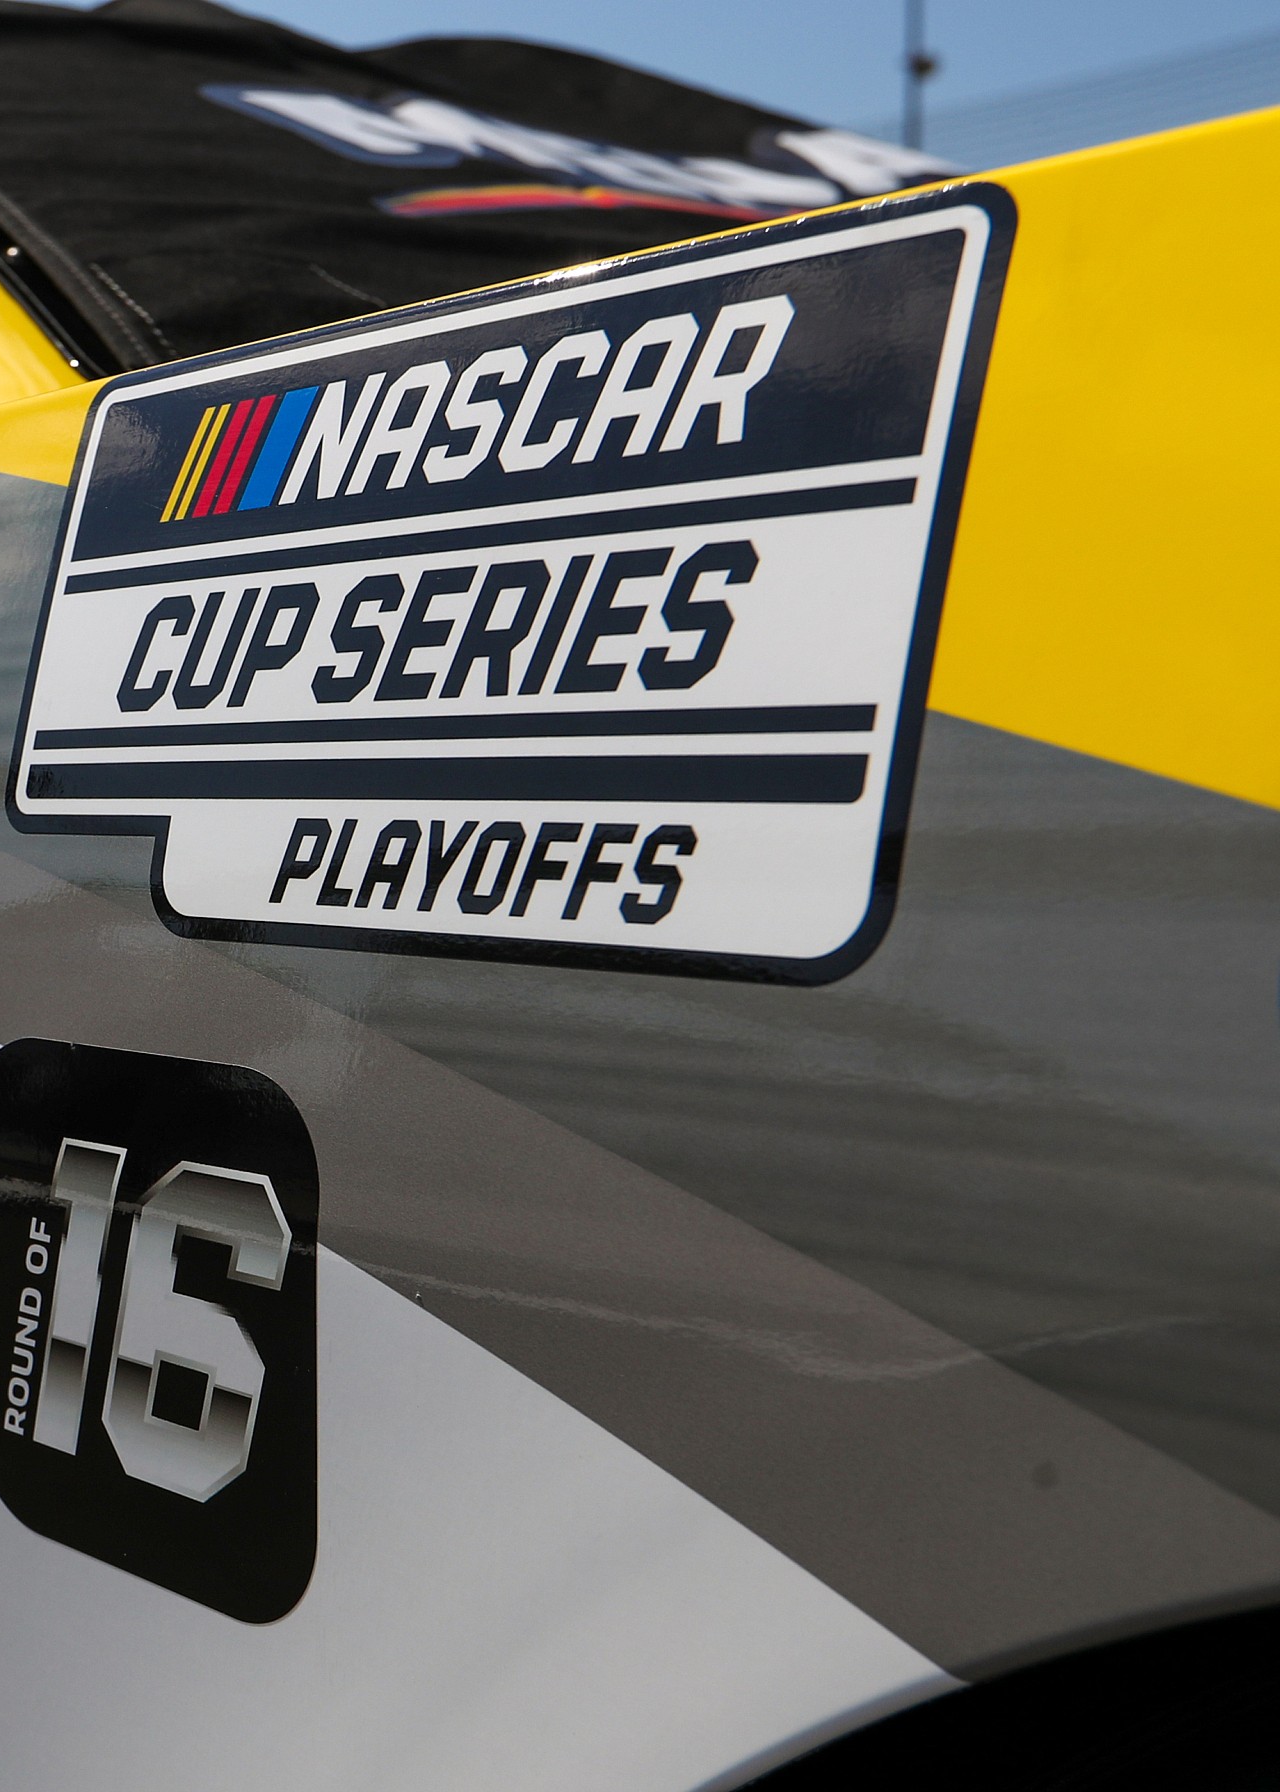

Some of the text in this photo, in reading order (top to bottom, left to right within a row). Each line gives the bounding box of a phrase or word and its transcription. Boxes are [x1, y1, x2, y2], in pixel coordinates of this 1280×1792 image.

[280, 294, 796, 504] NASCAR
[117, 539, 760, 713] CUP SERIES
[269, 817, 698, 925] PLAYOFFS
[4, 1216, 52, 1436] ROUND OF
[33, 1137, 293, 1503] 16
